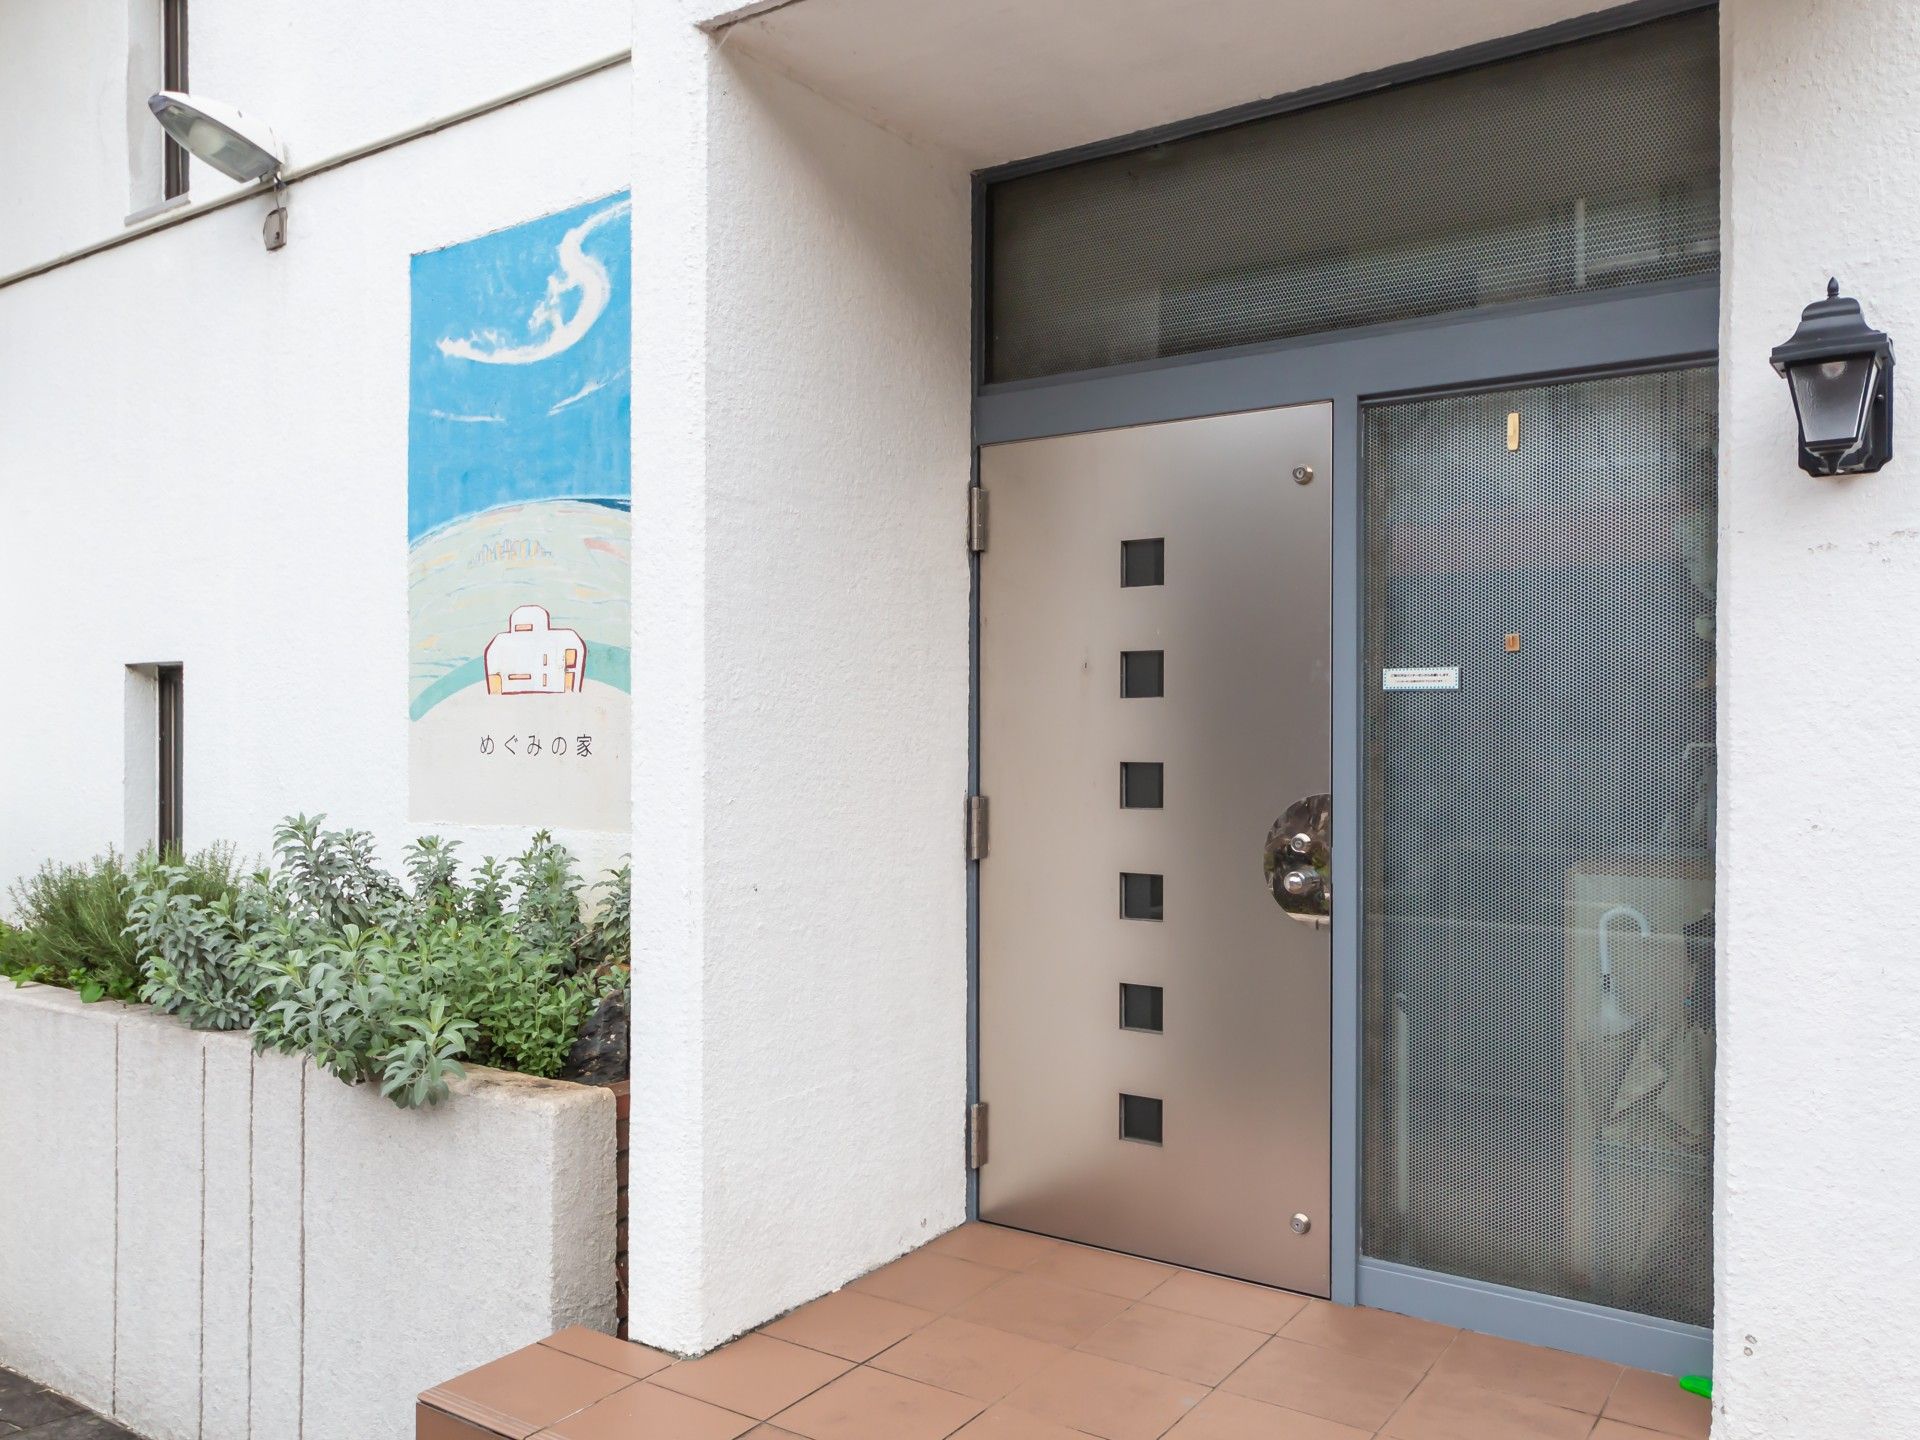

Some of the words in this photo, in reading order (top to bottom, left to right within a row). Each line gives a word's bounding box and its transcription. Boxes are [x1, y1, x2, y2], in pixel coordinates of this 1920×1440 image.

[479, 733, 593, 758] めぐみの家
